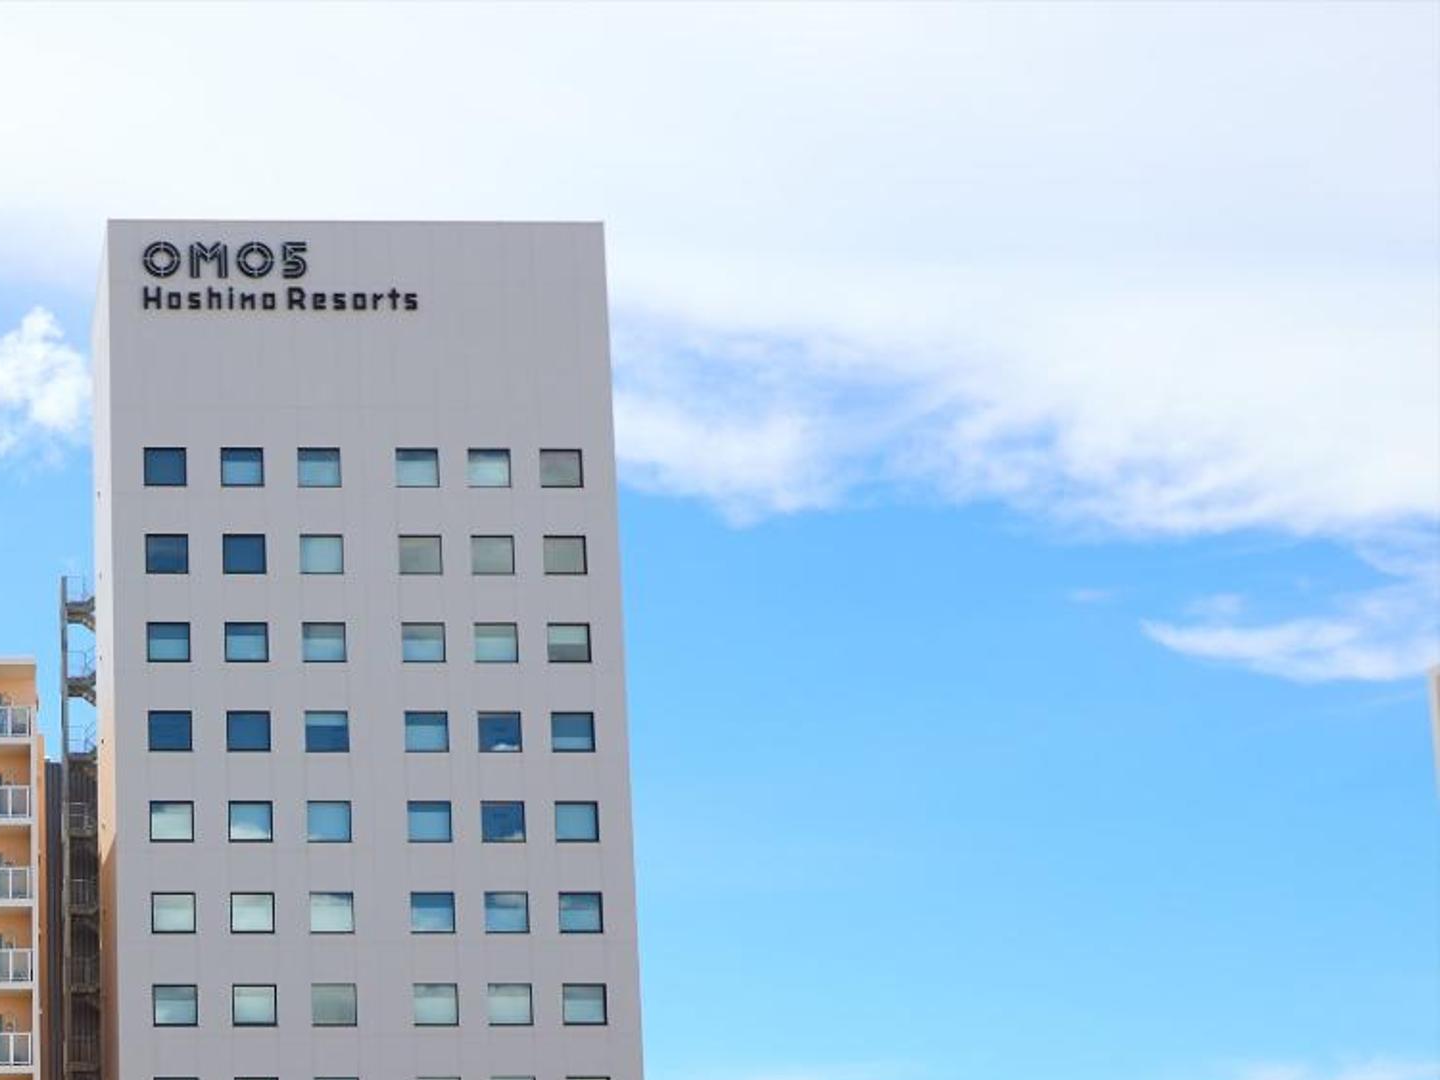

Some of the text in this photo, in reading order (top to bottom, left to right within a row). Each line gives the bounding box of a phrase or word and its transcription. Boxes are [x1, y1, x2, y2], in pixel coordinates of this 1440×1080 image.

[143, 241, 308, 279] OMO5
[143, 286, 419, 311] Hoshino Resorts
